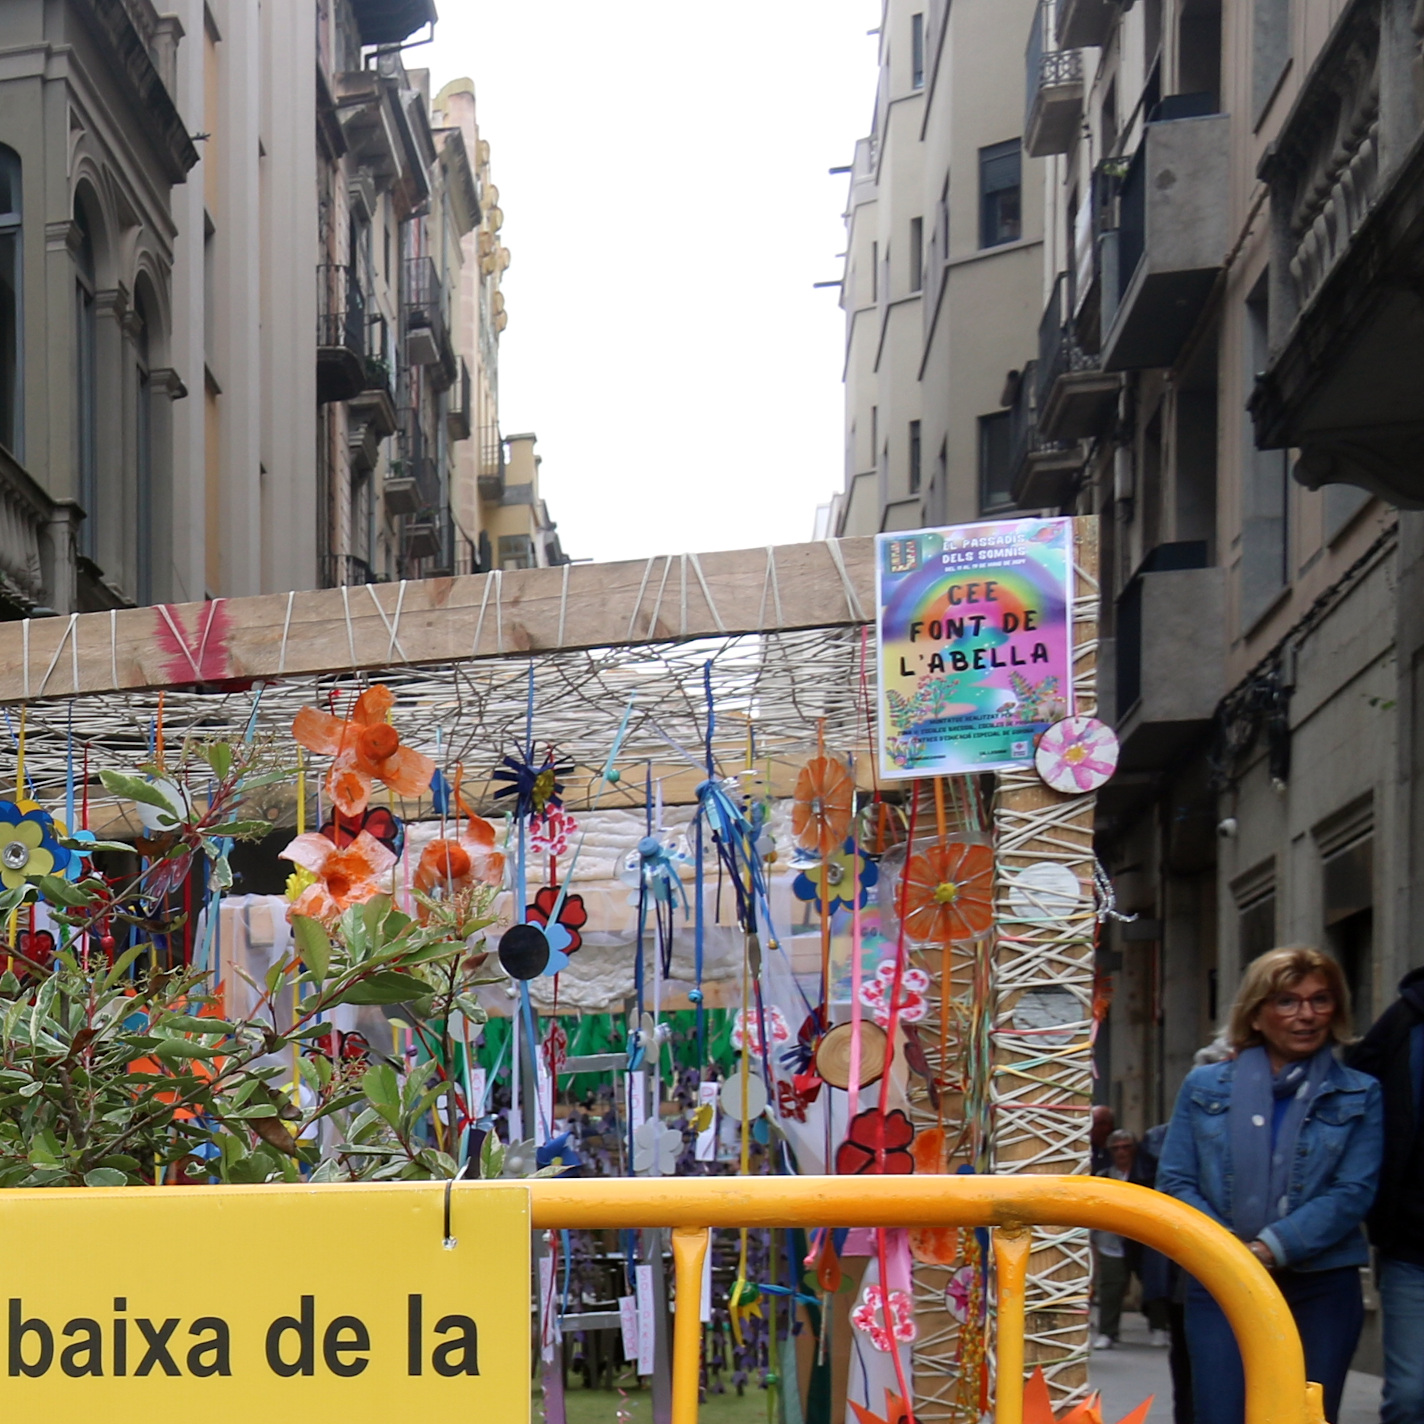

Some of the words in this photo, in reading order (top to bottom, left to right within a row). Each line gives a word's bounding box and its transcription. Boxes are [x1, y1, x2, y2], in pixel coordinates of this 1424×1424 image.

[942, 551, 974, 564] DELS
[978, 546, 1026, 560] SOMNIS
[943, 540, 957, 551] EL
[948, 581, 999, 606] CEE
[910, 615, 986, 643] FONT
[1002, 610, 1037, 634] DE
[900, 643, 1049, 677] L'ABELLA
[8, 1297, 232, 1378] baixa
[265, 1294, 371, 1378] de
[408, 1293, 480, 1378] la
